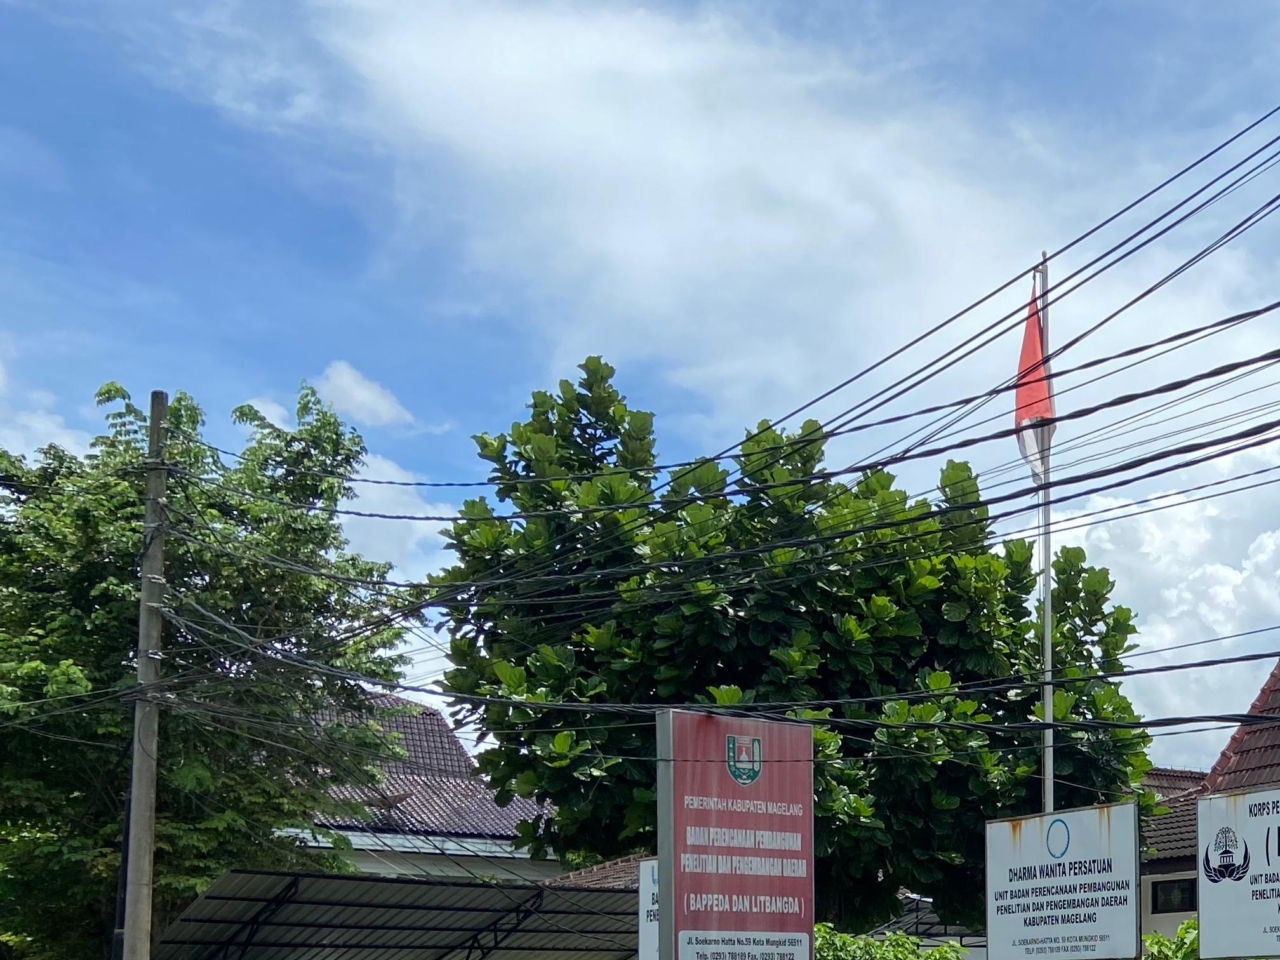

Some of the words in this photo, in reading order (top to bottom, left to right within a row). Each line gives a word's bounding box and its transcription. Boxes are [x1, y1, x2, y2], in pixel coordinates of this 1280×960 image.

[684, 796, 727, 810] PEMERINTAH
[728, 799, 766, 813] KABUPATEN
[767, 802, 803, 816] MAGELANG
[1249, 801, 1270, 817] KORPS
[686, 826, 708, 845] BADAN
[710, 827, 754, 848] PERENCANAAN
[756, 830, 801, 851] PEMBANGUNAN
[681, 854, 717, 874] PENELITIAN
[718, 855, 731, 874] DAN
[732, 856, 782, 876] PENGEMBANGAN
[783, 858, 806, 877] DAERAH
[1009, 866, 1037, 882] DHARMA
[1039, 863, 1066, 879] WANITA
[1069, 858, 1112, 876] PERSATUAN
[1250, 874, 1263, 885] UNIT
[995, 891, 1008, 901] UNIT
[1010, 888, 1029, 900] BADAN
[1031, 884, 1077, 897] PERENCANAAN
[1079, 880, 1129, 893] PEMBANGUNAN
[690, 894, 730, 912] BAPPEDA
[732, 895, 749, 912] DAN
[752, 896, 800, 913] LITBANGDA
[997, 904, 1030, 915] PENELITIAN
[1032, 902, 1044, 912] DAN
[1046, 897, 1099, 911] PENGEMBANGAN
[1101, 895, 1128, 907] DAERAH
[1024, 915, 1059, 927] KABUPATEN
[1061, 913, 1097, 924] MAGELANG
[695, 937, 720, 945] Soekarno
[766, 938, 786, 948] Mungkid
[1018, 937, 1053, 946] SOEKARNO-HATTA
[696, 952, 708, 960] Telp.
[747, 952, 758, 960] Fax.
